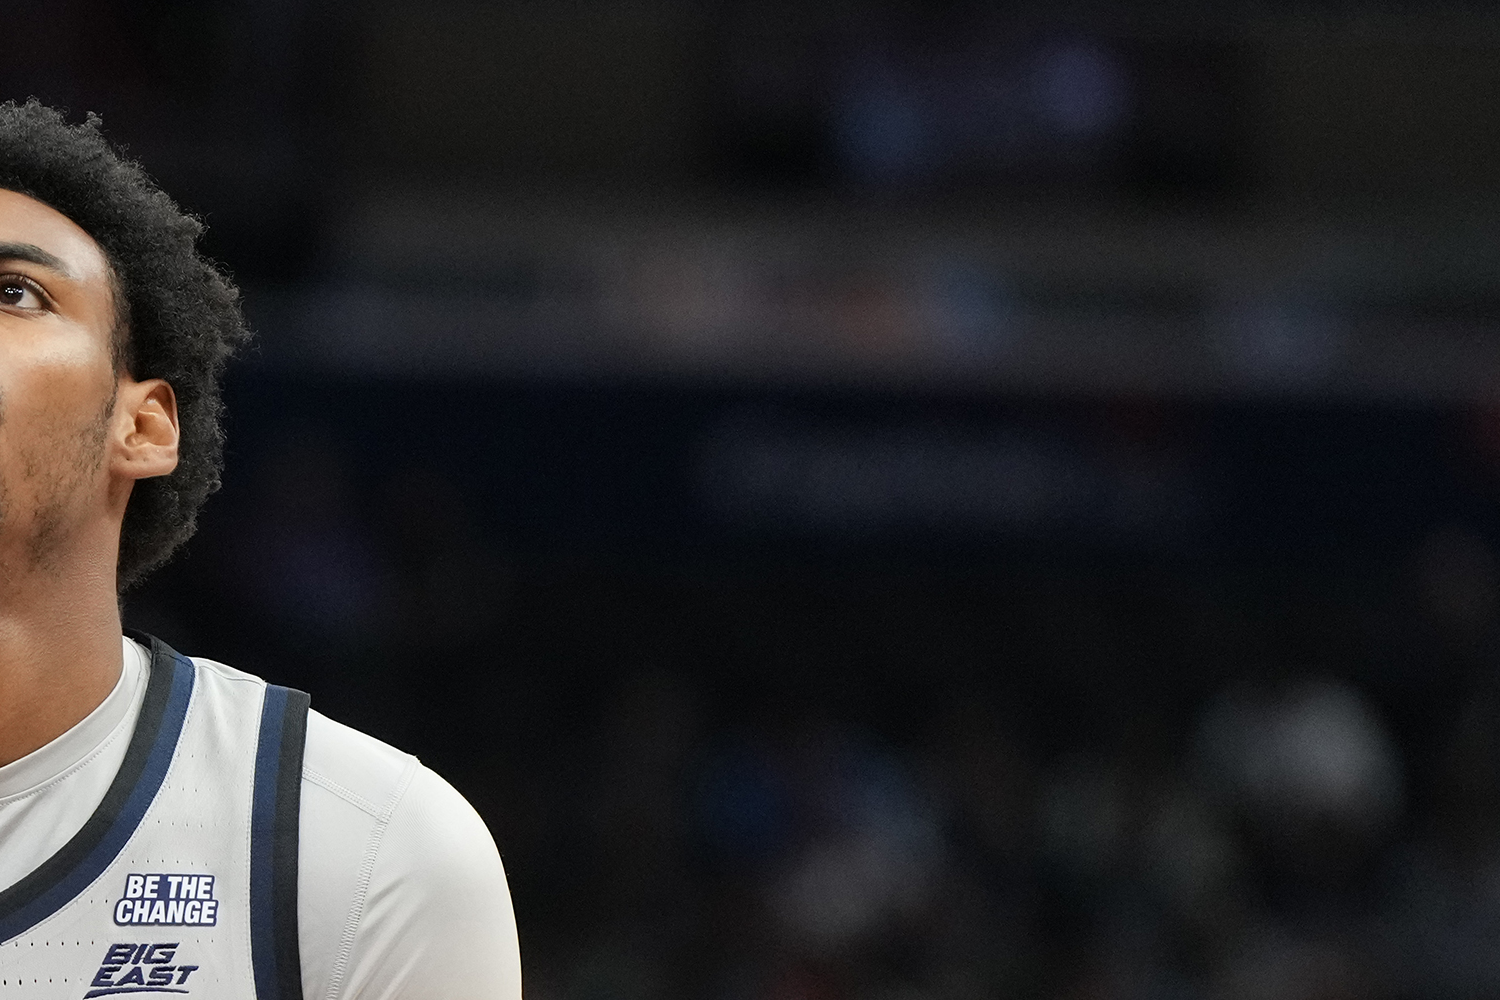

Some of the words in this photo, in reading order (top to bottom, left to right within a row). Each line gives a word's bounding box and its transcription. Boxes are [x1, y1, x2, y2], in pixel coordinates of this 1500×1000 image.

[126, 875, 160, 899] BE
[167, 875, 214, 900] THE
[115, 900, 216, 924] CHANGE
[102, 942, 180, 965] BIG
[89, 965, 199, 987] EAST
